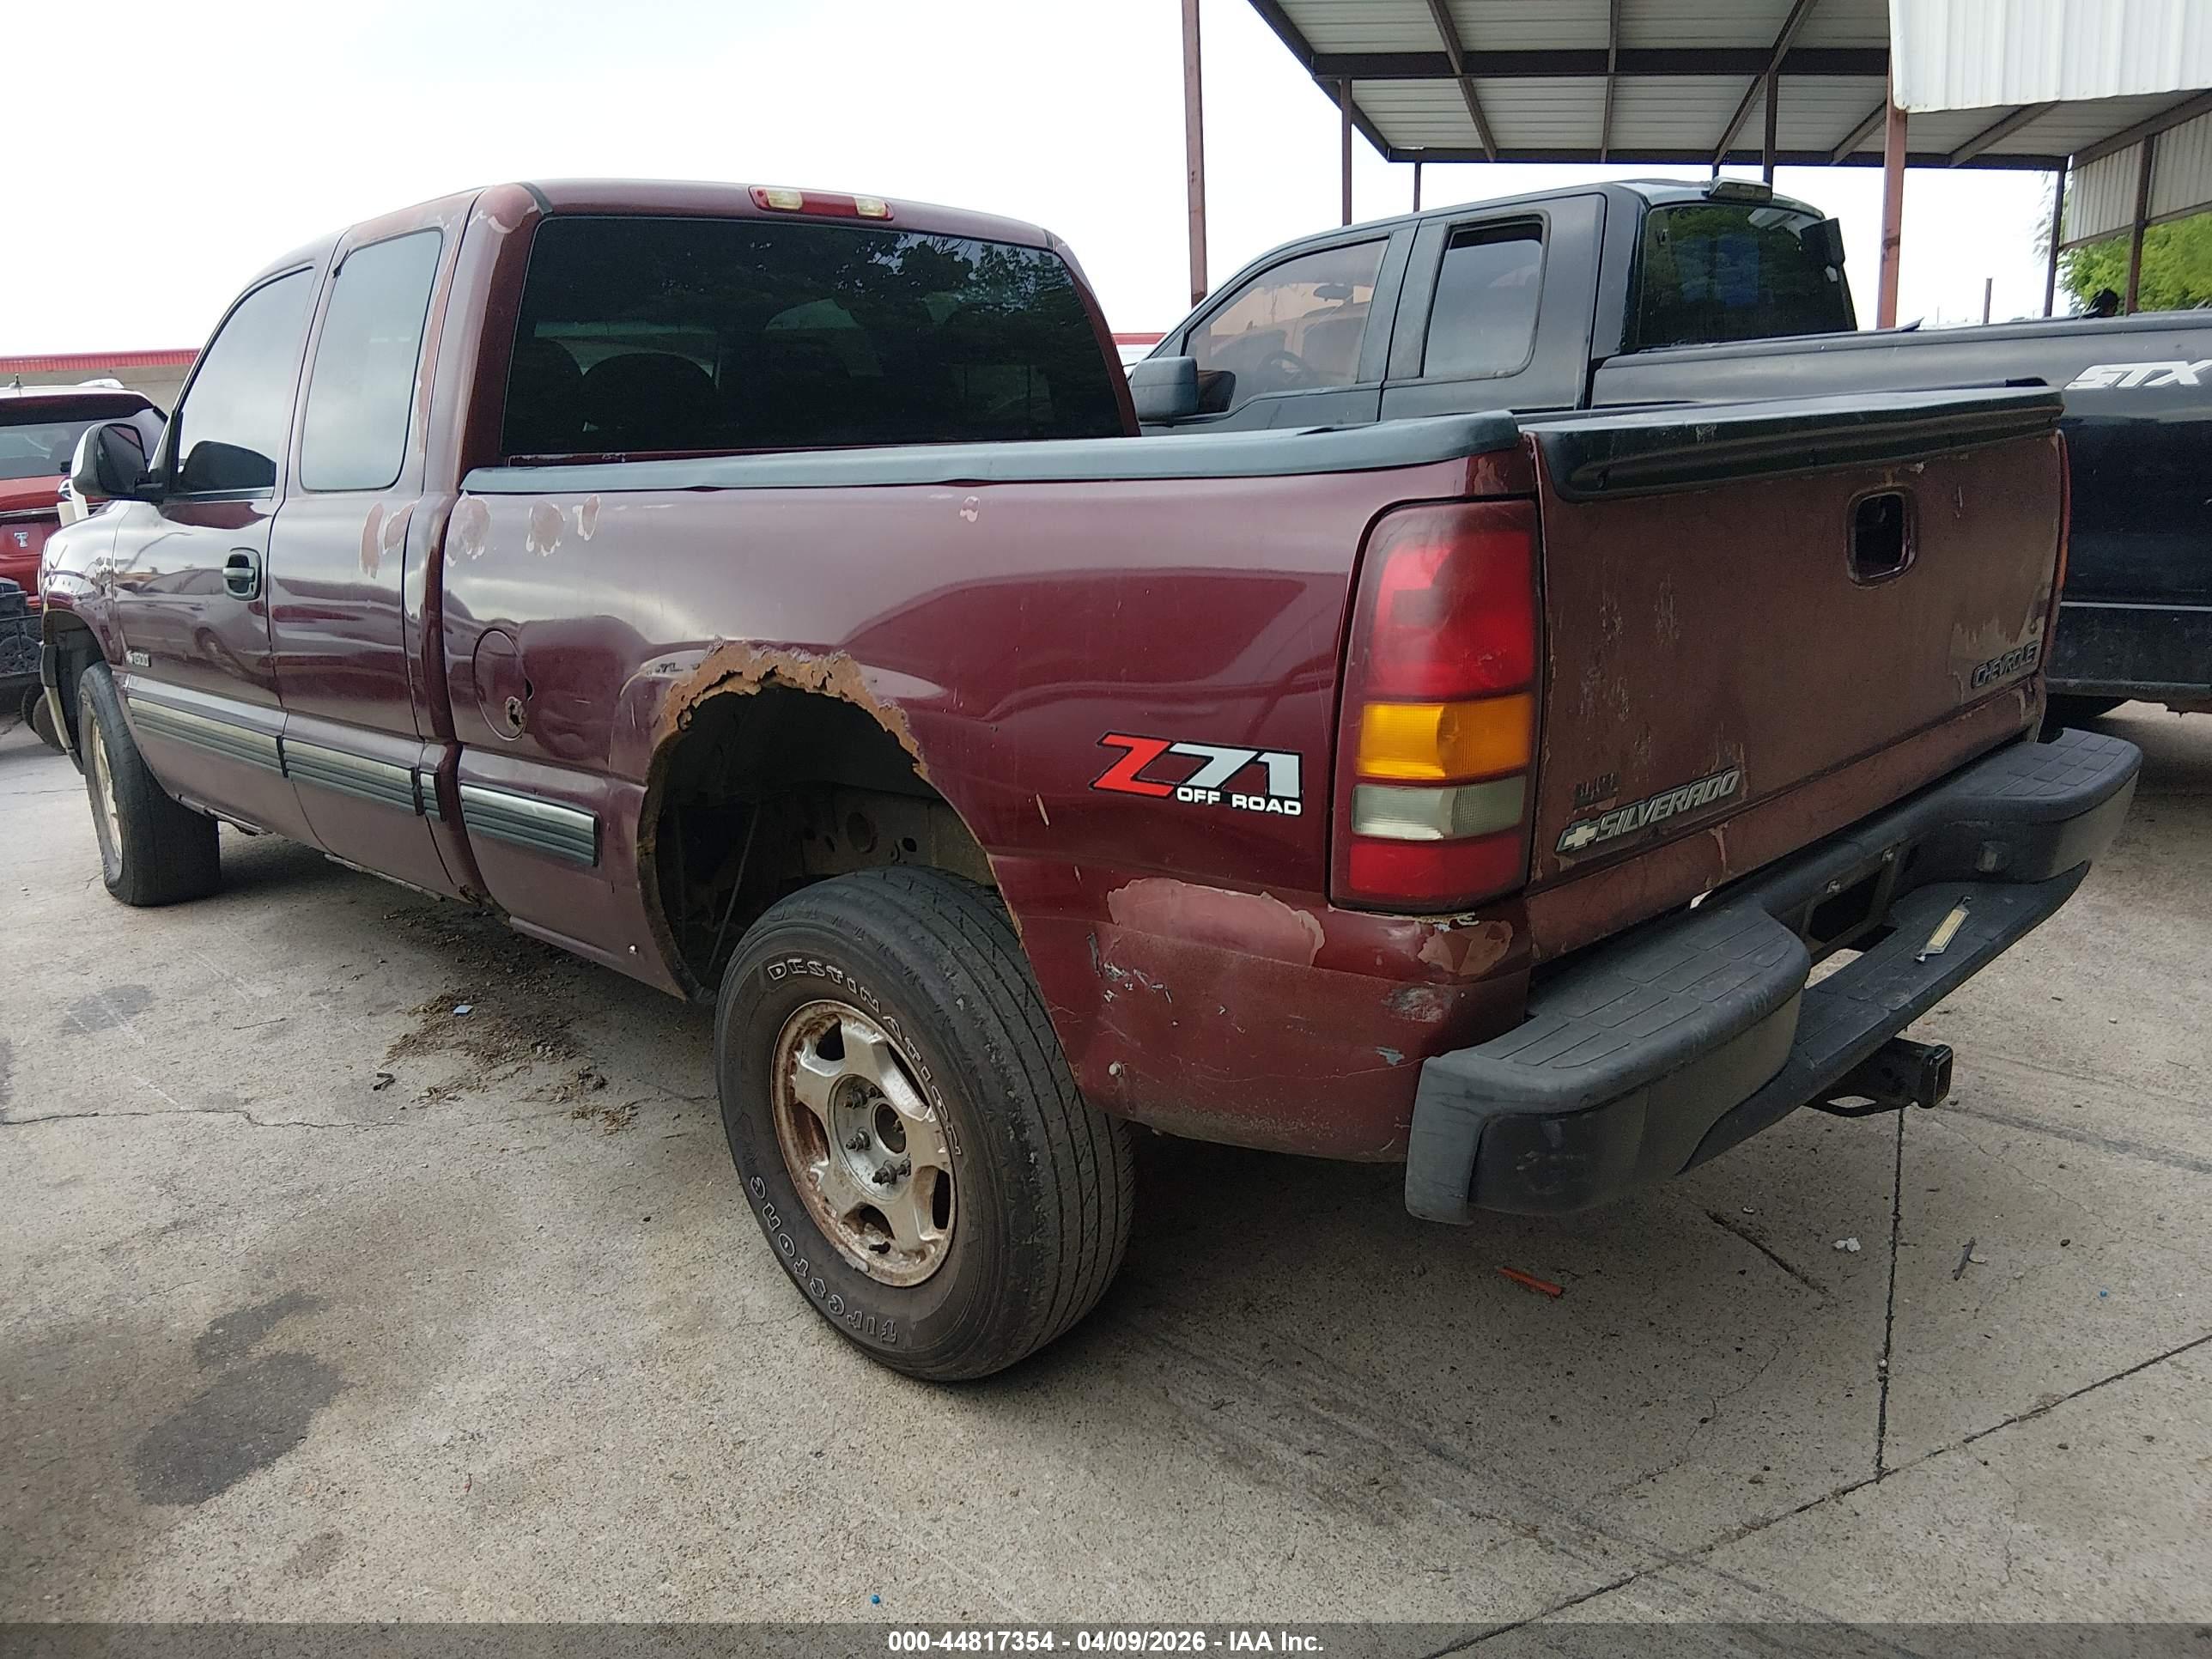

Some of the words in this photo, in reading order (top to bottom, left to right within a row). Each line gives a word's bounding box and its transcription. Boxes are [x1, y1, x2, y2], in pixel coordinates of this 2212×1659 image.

[2063, 359, 2212, 390] STX
[1090, 731, 1303, 798] Z71
[1176, 787, 1221, 805] OFF
[1231, 797, 1302, 816] ROAD
[1595, 769, 1741, 842] SILVERADO
[767, 957, 962, 1155] DESTINATION
